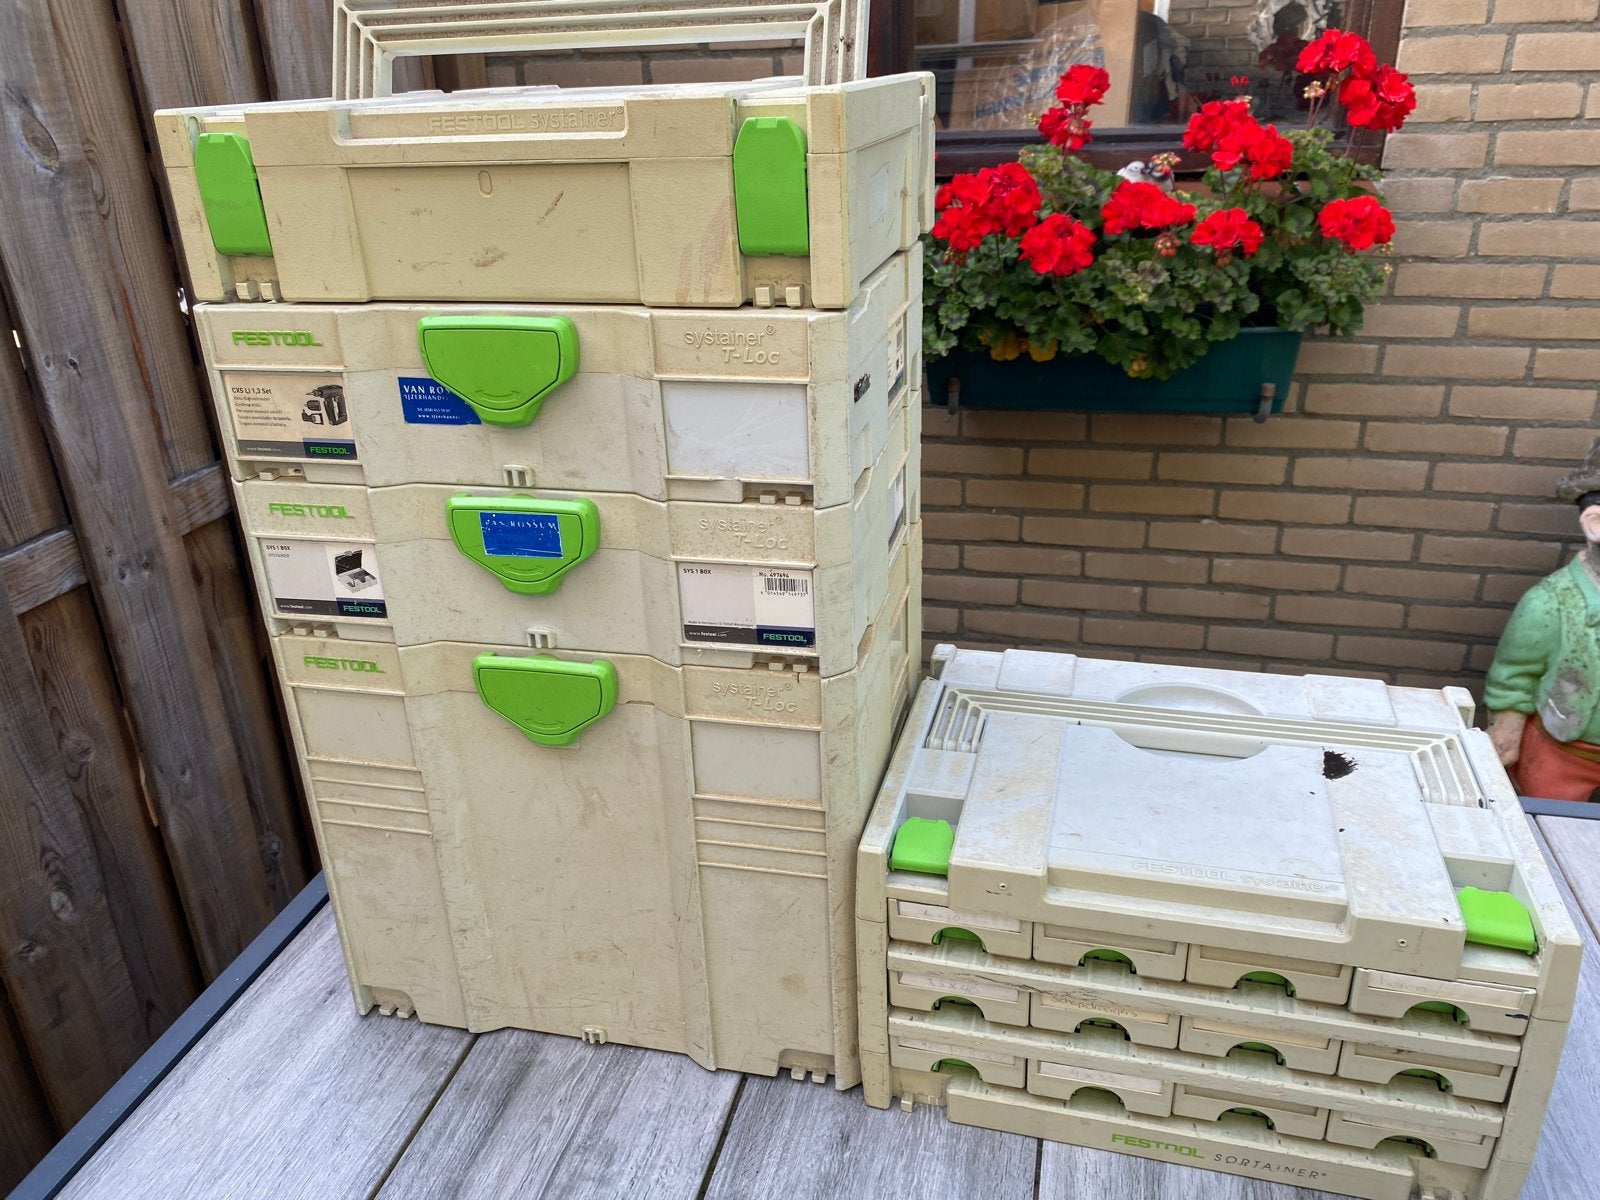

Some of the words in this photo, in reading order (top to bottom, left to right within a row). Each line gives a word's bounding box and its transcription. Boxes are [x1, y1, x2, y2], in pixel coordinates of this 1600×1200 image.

[428, 114, 525, 132] FESTOOL
[231, 330, 323, 346] FESTOOL
[721, 346, 780, 364] T-Loc
[403, 385, 425, 394] VAN
[309, 446, 350, 455] FESTOOL
[268, 502, 355, 519] FESTOOL
[733, 532, 788, 549] T-Loc
[343, 605, 382, 614] FESTOOL
[762, 633, 807, 642] FESTOOL
[303, 655, 386, 674] FESTOOL
[745, 695, 797, 713] T-Loc
[1132, 859, 1236, 883] FESTOOL
[1111, 1132, 1206, 1160] FESTOOL
